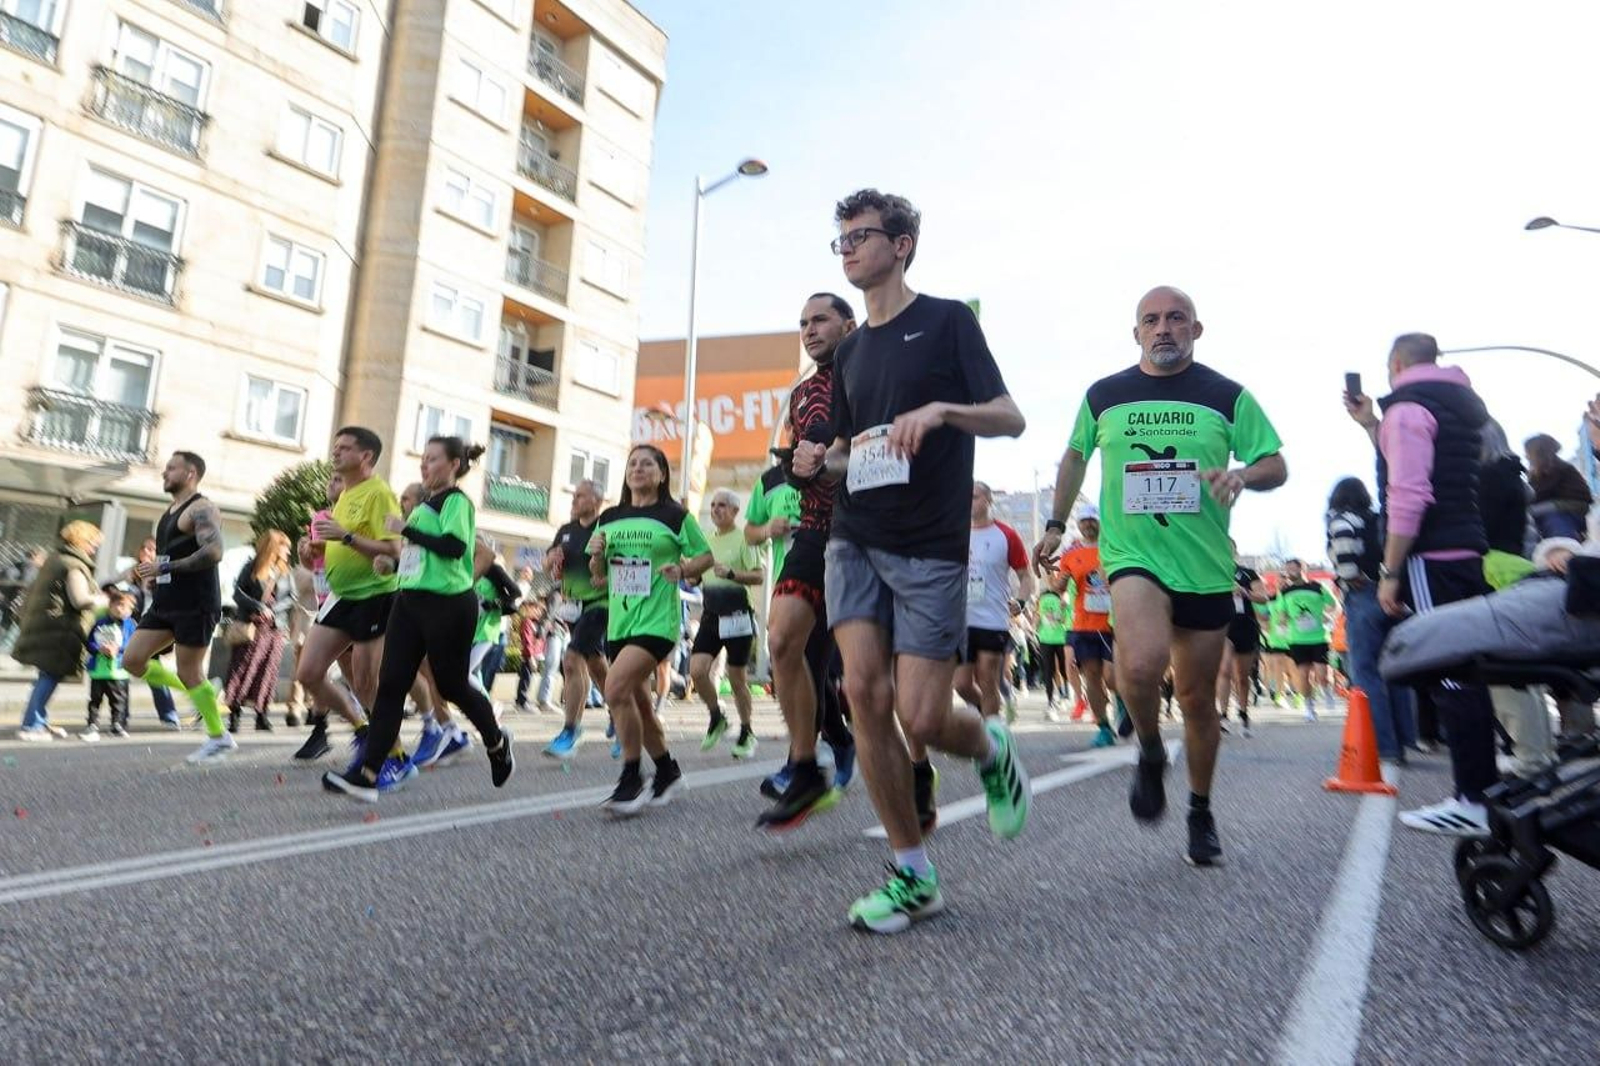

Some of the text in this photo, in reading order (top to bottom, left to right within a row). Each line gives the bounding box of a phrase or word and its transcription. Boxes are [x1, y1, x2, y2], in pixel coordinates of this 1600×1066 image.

[1128, 411, 1195, 425] CALVARIO
[1139, 428, 1198, 437] Santander
[1144, 476, 1177, 493] 117
[610, 530, 653, 540] CALVARIO
